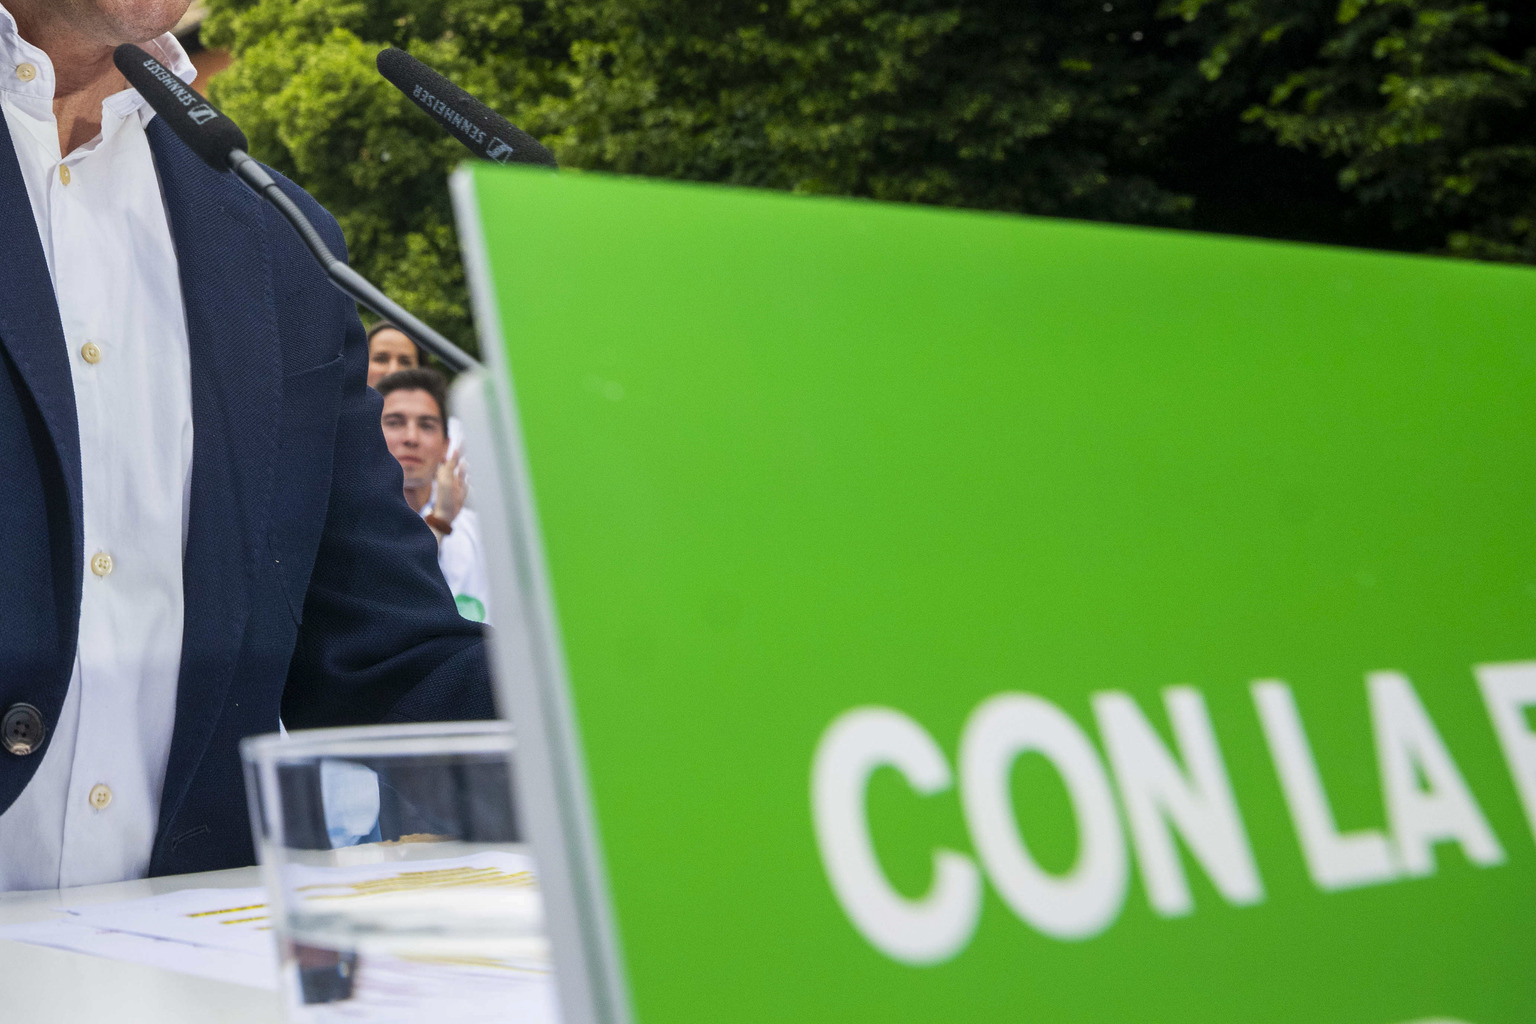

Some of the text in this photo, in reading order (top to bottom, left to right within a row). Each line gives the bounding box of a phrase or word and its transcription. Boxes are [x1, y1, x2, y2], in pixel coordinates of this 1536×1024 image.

[143, 59, 198, 106] SENNHEISER
[413, 84, 487, 145] SENNHEISER
[810, 685, 1266, 967] CON
[1249, 670, 1507, 893] LA
